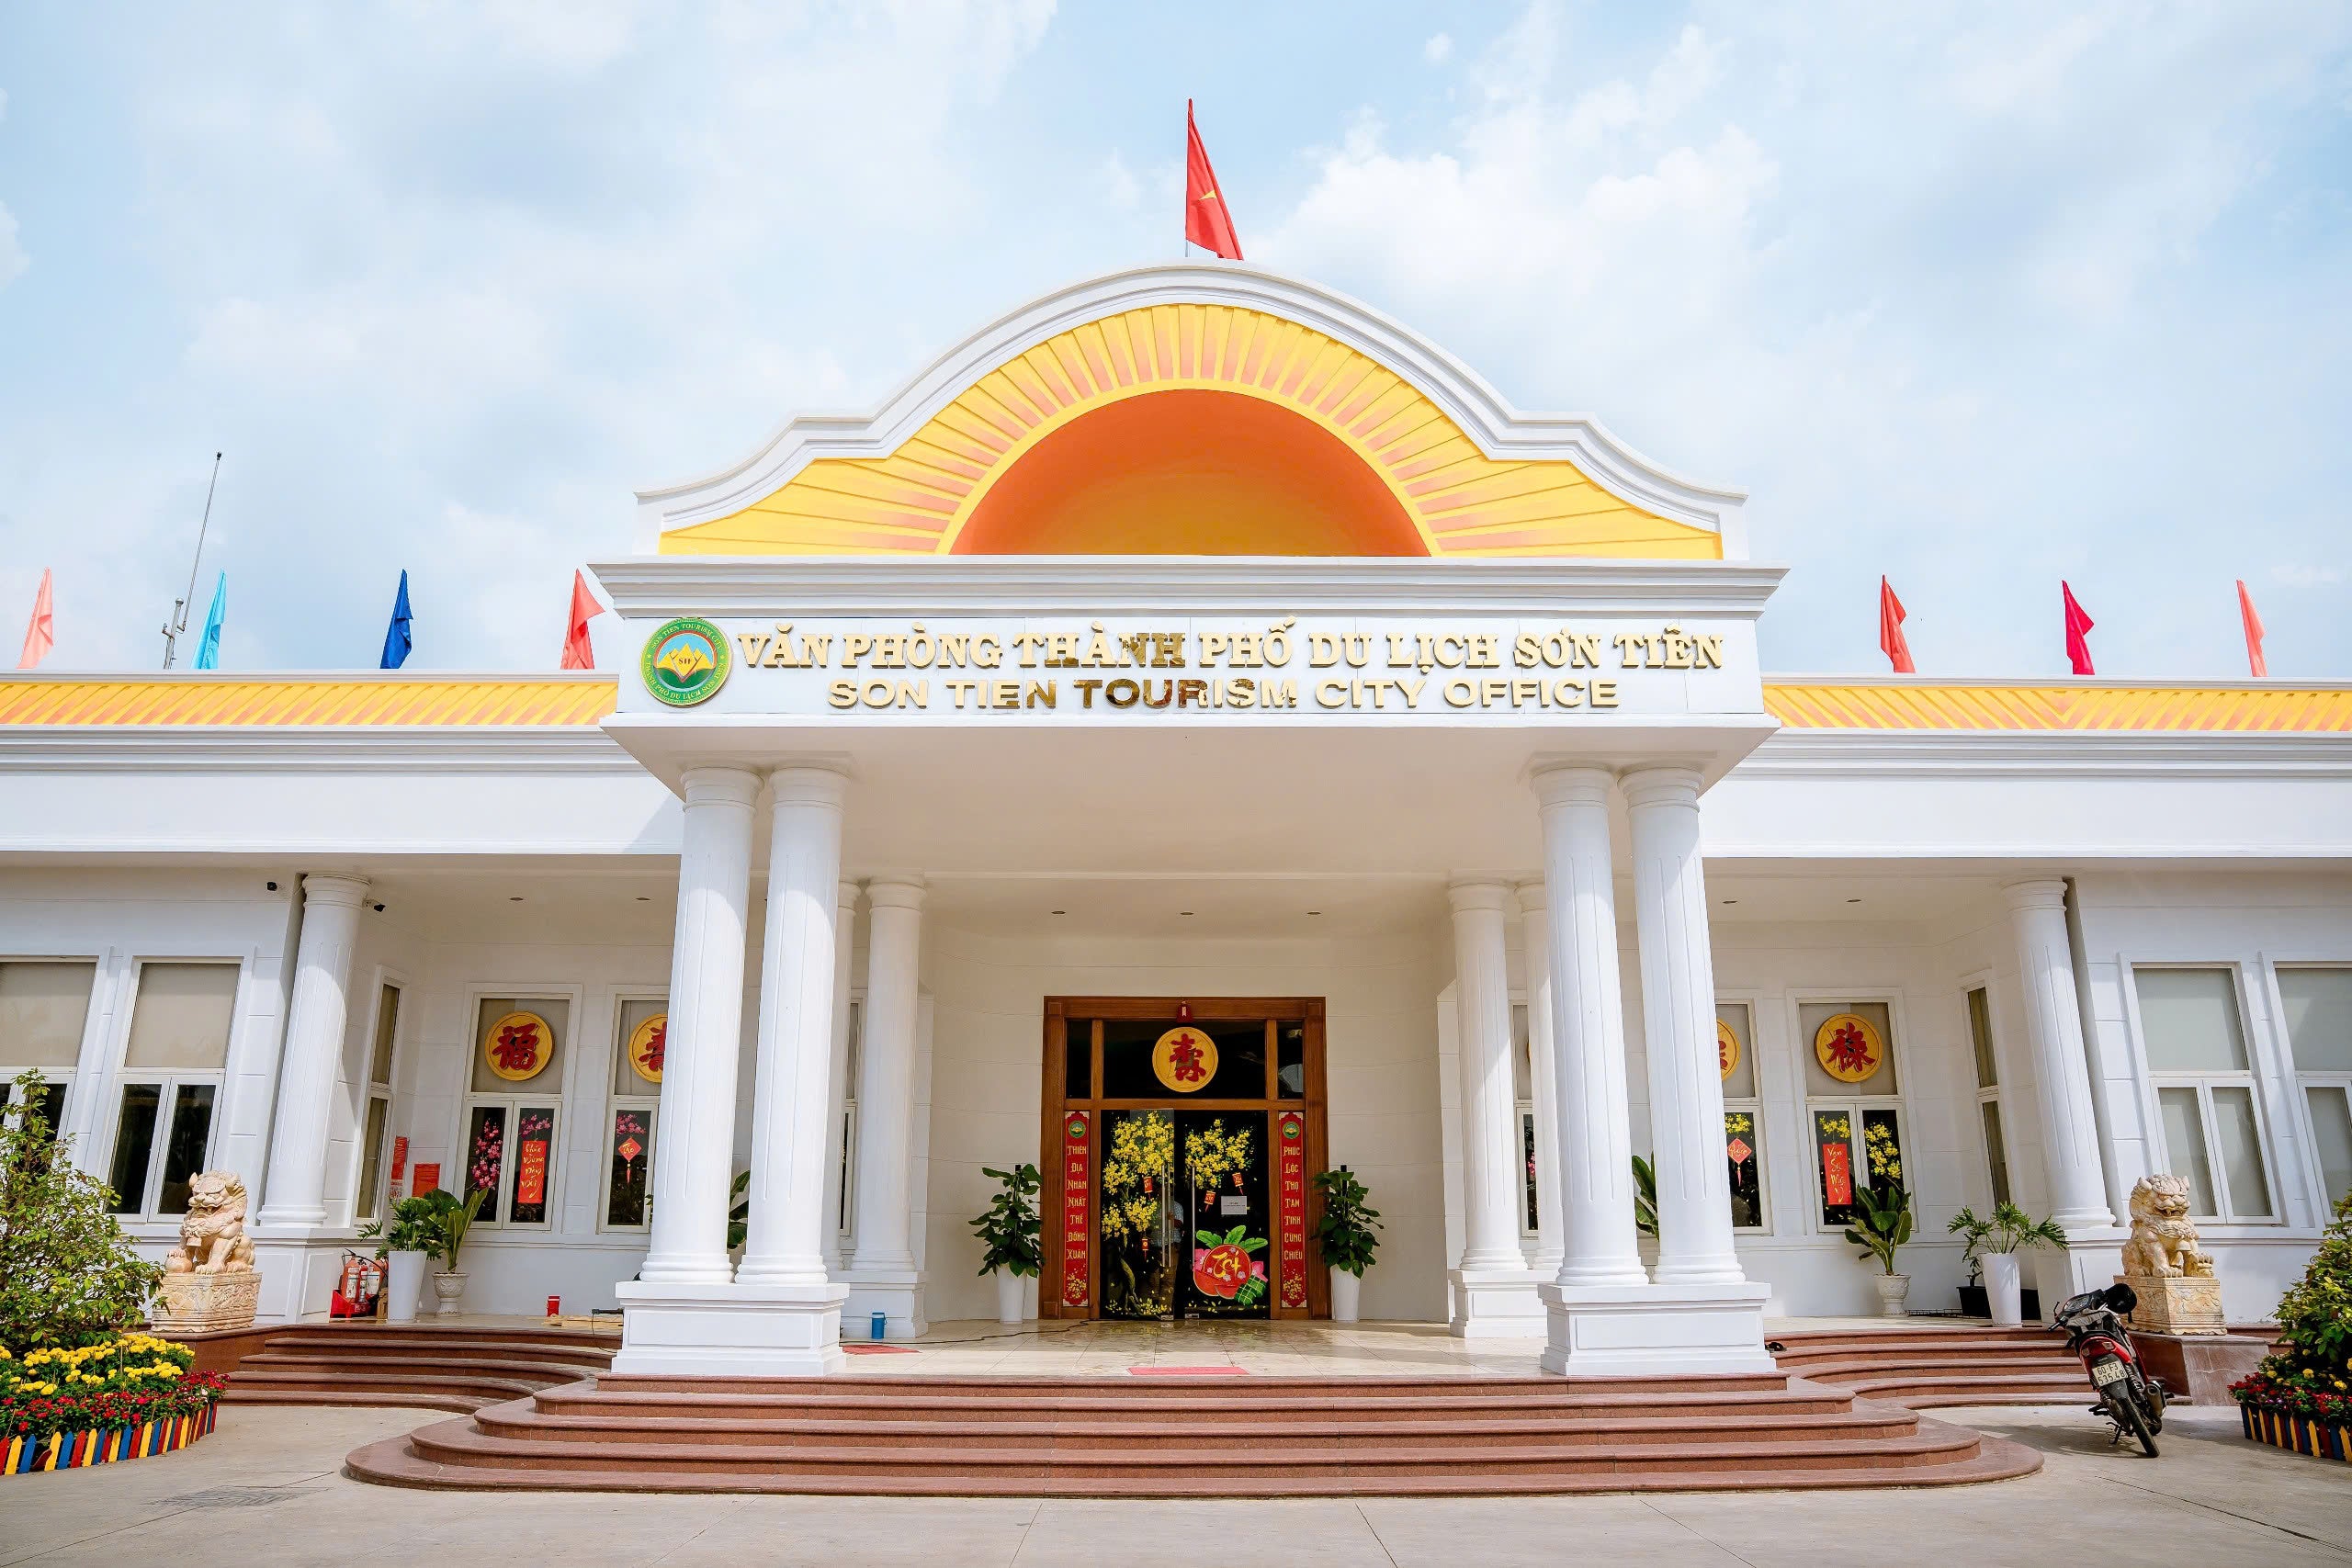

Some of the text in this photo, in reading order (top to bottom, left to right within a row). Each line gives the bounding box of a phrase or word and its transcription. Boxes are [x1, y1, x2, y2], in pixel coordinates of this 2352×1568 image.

[738, 615, 1724, 675] VĂN PHÒNG THÀNH PHỐ DU LỊCH SƠN TIÊN
[828, 678, 1620, 709] SON TIEN TOURISM CITY OFFICE
[492, 1021, 540, 1072] 福
[2098, 1370, 2126, 1385] 535.48
